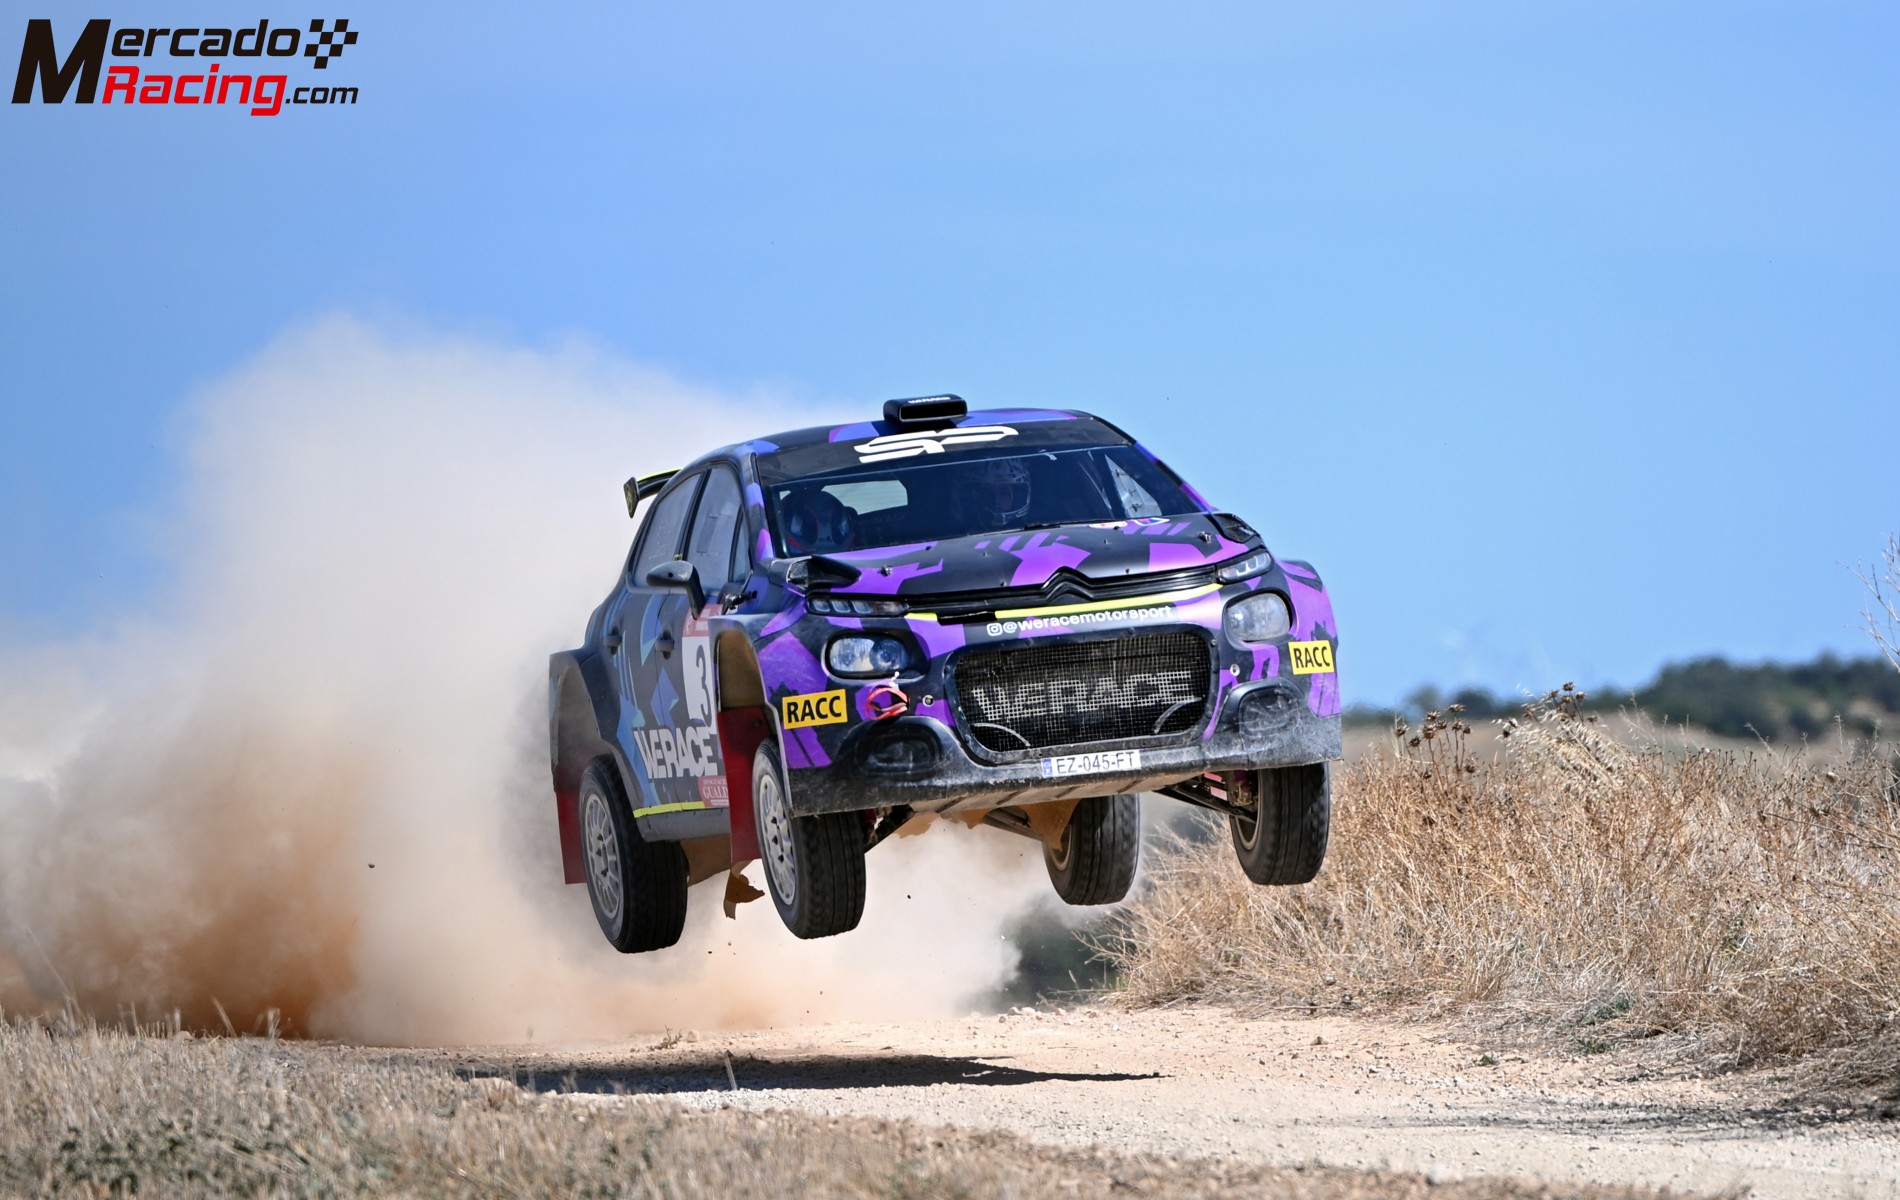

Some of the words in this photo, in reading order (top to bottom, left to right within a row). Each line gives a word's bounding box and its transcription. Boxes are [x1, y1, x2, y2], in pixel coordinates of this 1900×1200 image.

[1003, 605, 1173, 634] @weracemotorsport
[1293, 646, 1330, 668] RACC
[696, 645, 712, 727] 3
[972, 671, 1193, 720] WERACE
[787, 695, 842, 723] RACC
[634, 726, 718, 779] WERACE
[1056, 751, 1134, 774] EZ-045-FT
